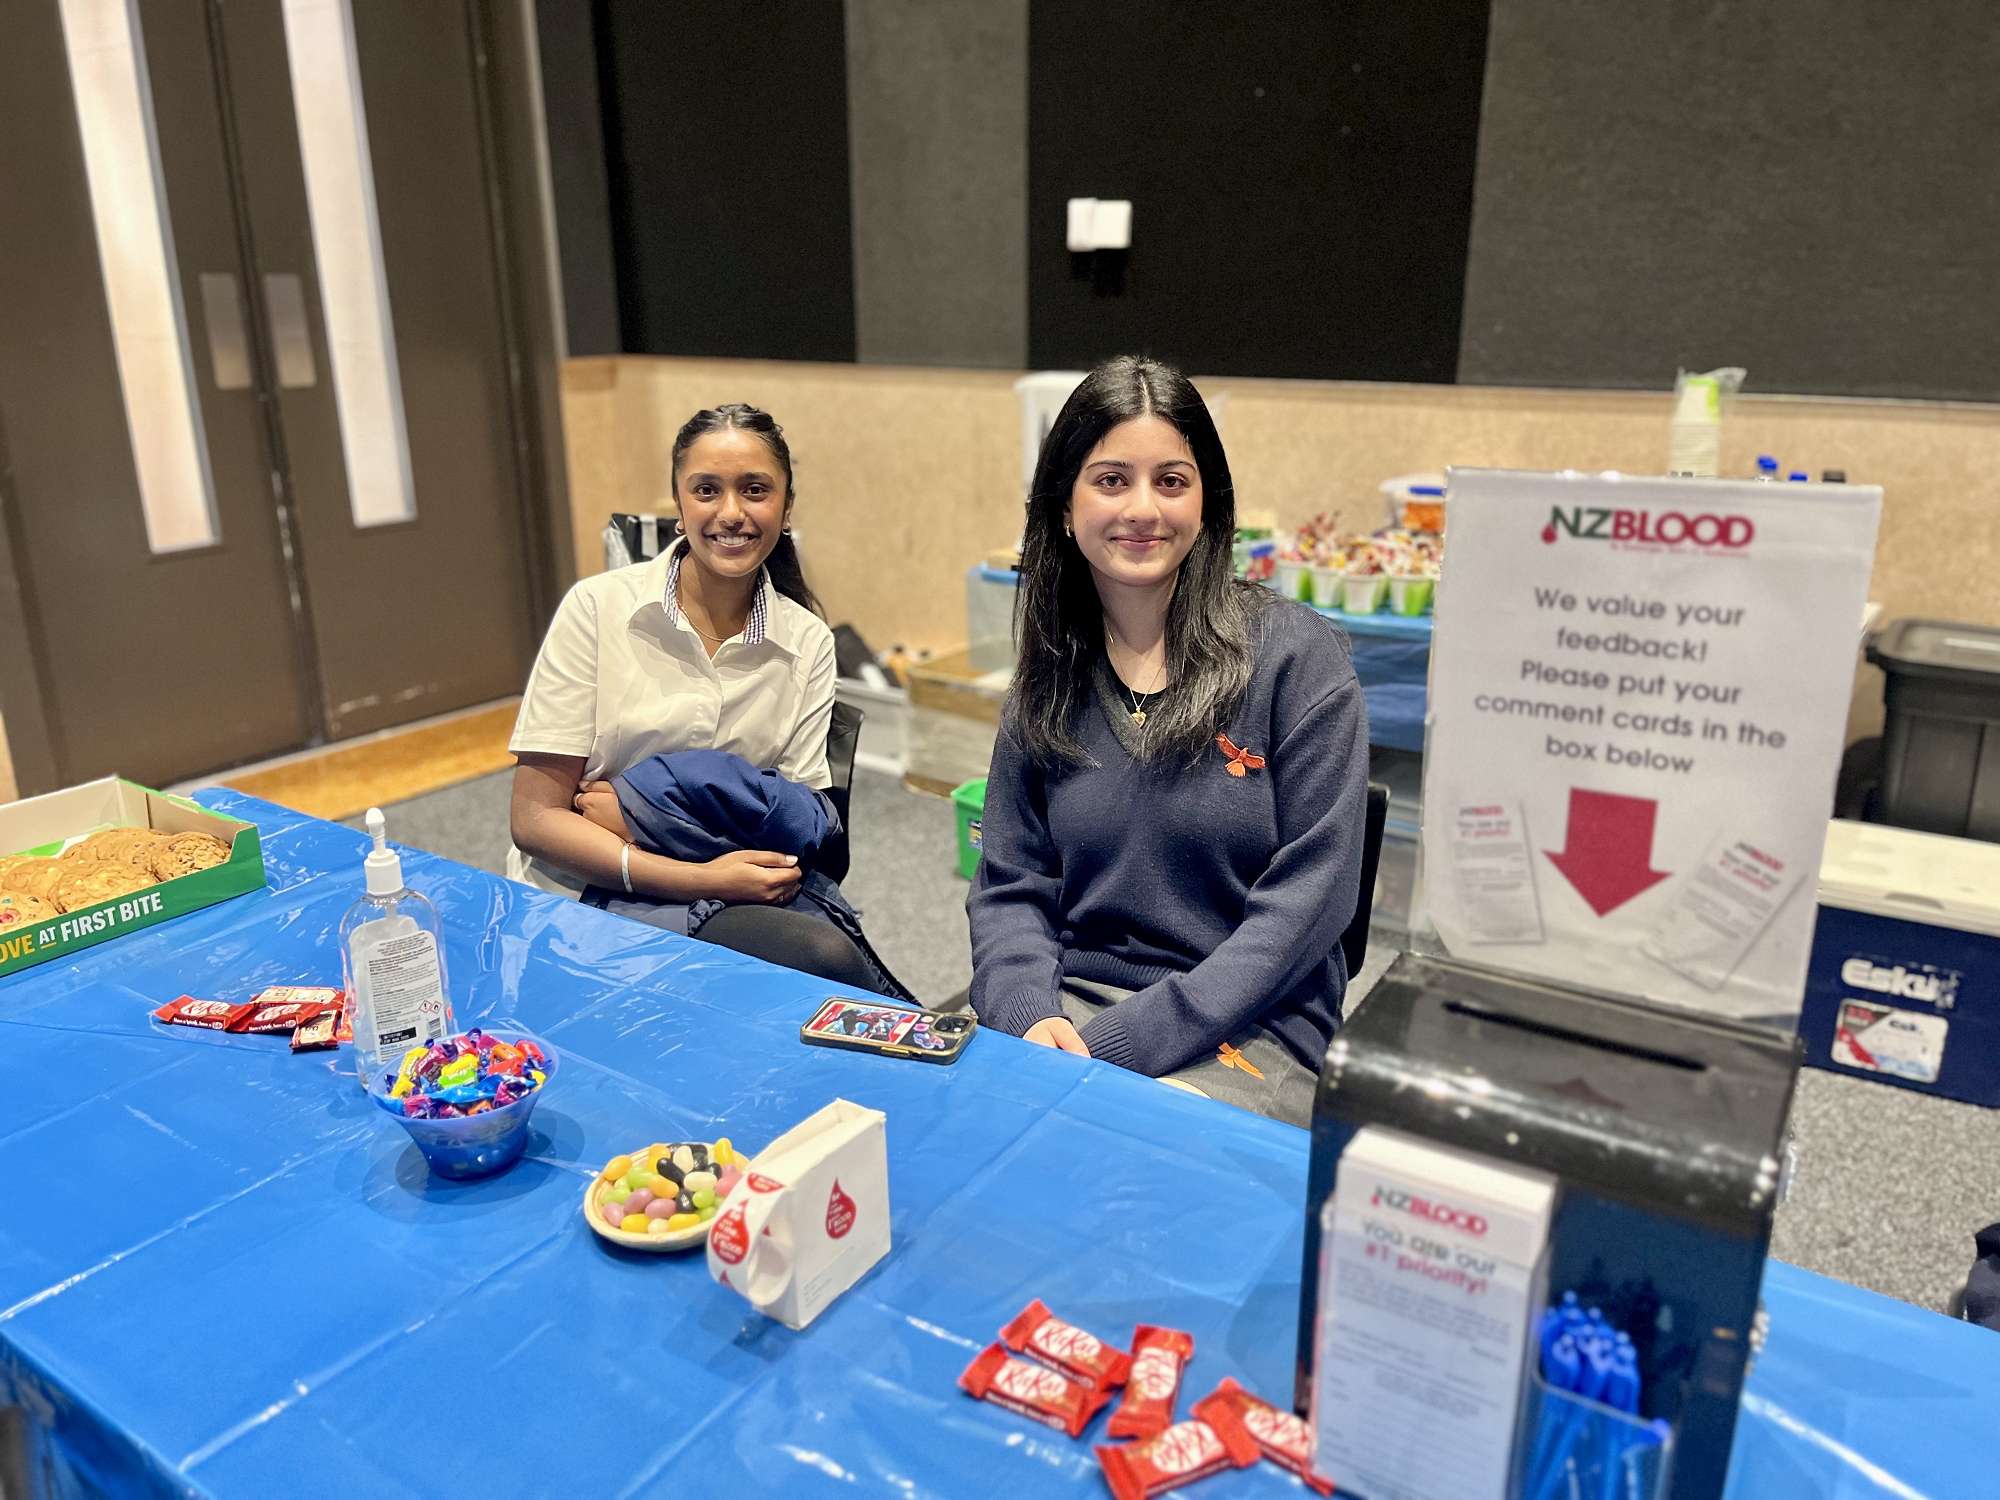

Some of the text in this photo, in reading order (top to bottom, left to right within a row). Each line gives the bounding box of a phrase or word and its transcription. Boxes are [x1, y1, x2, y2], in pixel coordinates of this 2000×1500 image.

[1545, 505, 1755, 549] NZBLOOD
[1533, 586, 1745, 627] We value your
[1556, 625, 1708, 663] feedback!
[1519, 659, 1743, 705] Please put your
[1474, 693, 1787, 750] comment cards in the
[1545, 734, 1695, 774] box below
[38, 926, 57, 946] AT
[60, 906, 117, 943] FIRST
[119, 892, 164, 923] BITE
[1371, 1185, 1489, 1237] NZBLOOD
[1363, 1218, 1498, 1276] You are our
[1365, 1241, 1489, 1296] #1 priority!
[1034, 1318, 1100, 1358] KitKat
[996, 1360, 1067, 1402] KitKat
